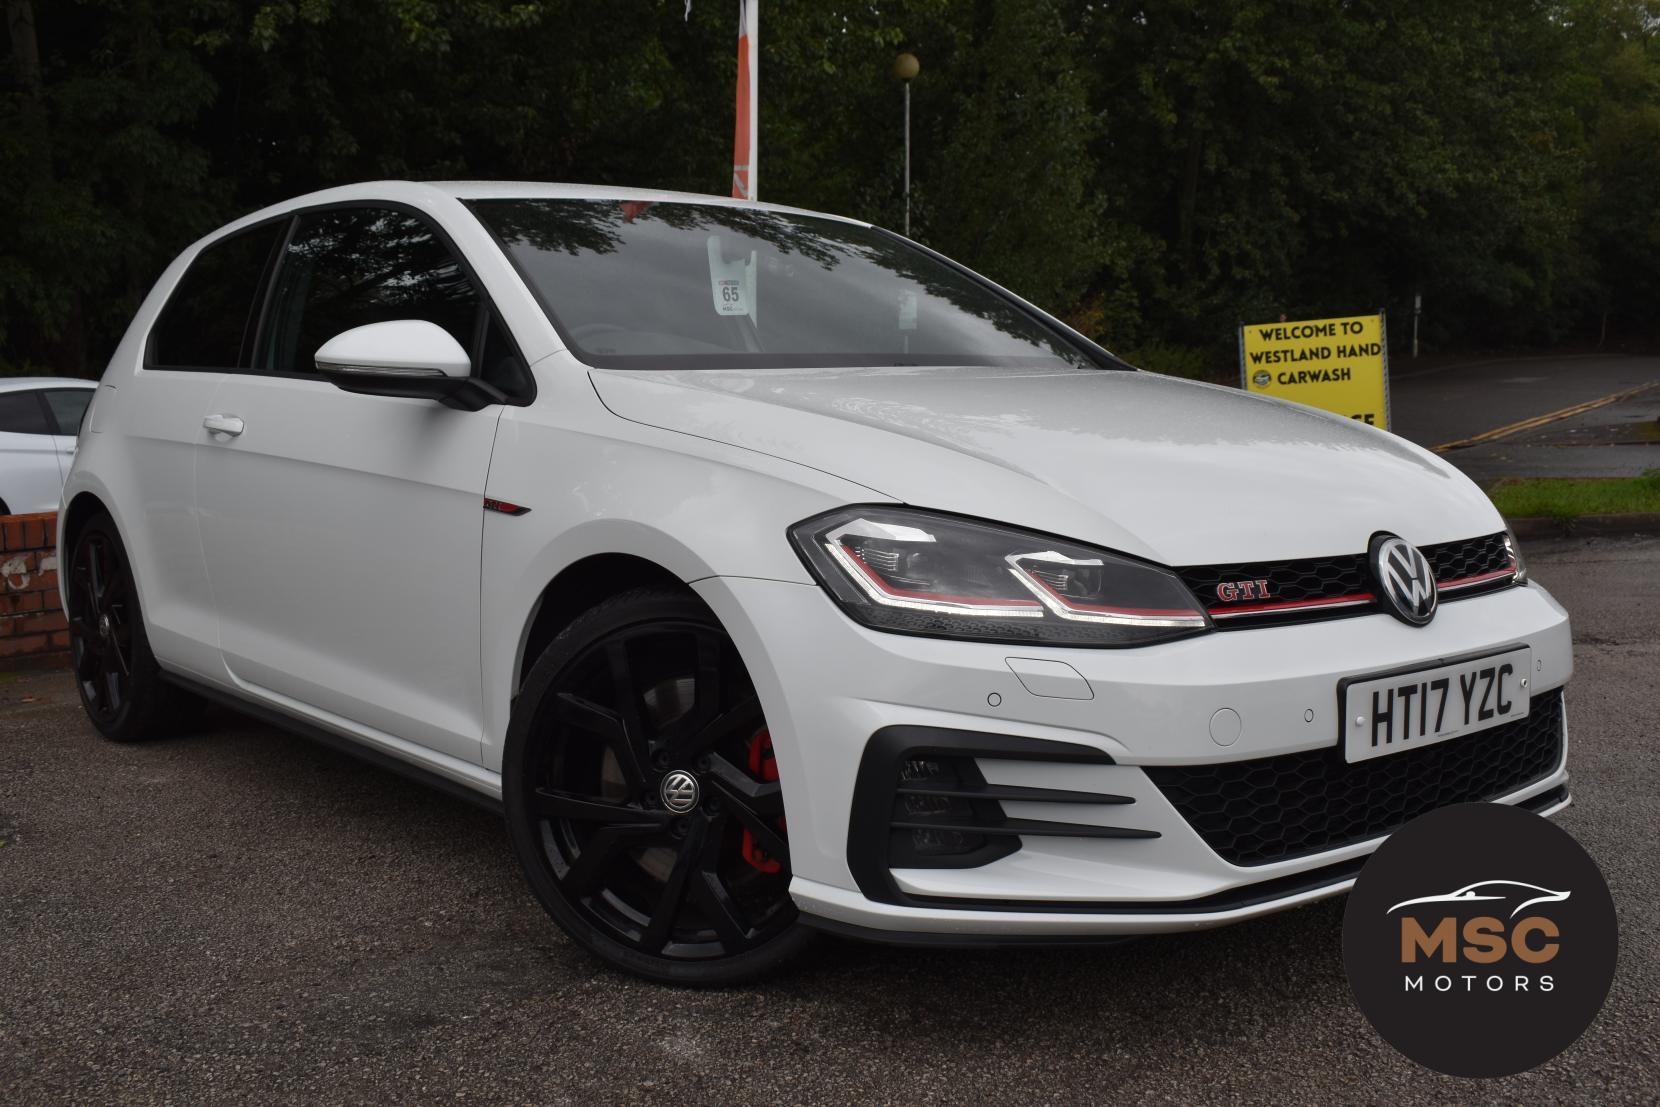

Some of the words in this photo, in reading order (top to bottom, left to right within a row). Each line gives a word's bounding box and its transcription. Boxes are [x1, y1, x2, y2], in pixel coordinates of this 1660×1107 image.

[722, 286, 740, 302] 65
[1259, 323, 1337, 341] WELCOME
[1341, 321, 1364, 335] TO
[1250, 346, 1332, 364] WESTLAND
[1336, 342, 1382, 359] HAND
[1277, 367, 1351, 385] CARWASH
[1216, 579, 1271, 602] GTI
[1371, 677, 1450, 747] HT17
[1459, 663, 1514, 726] YZC
